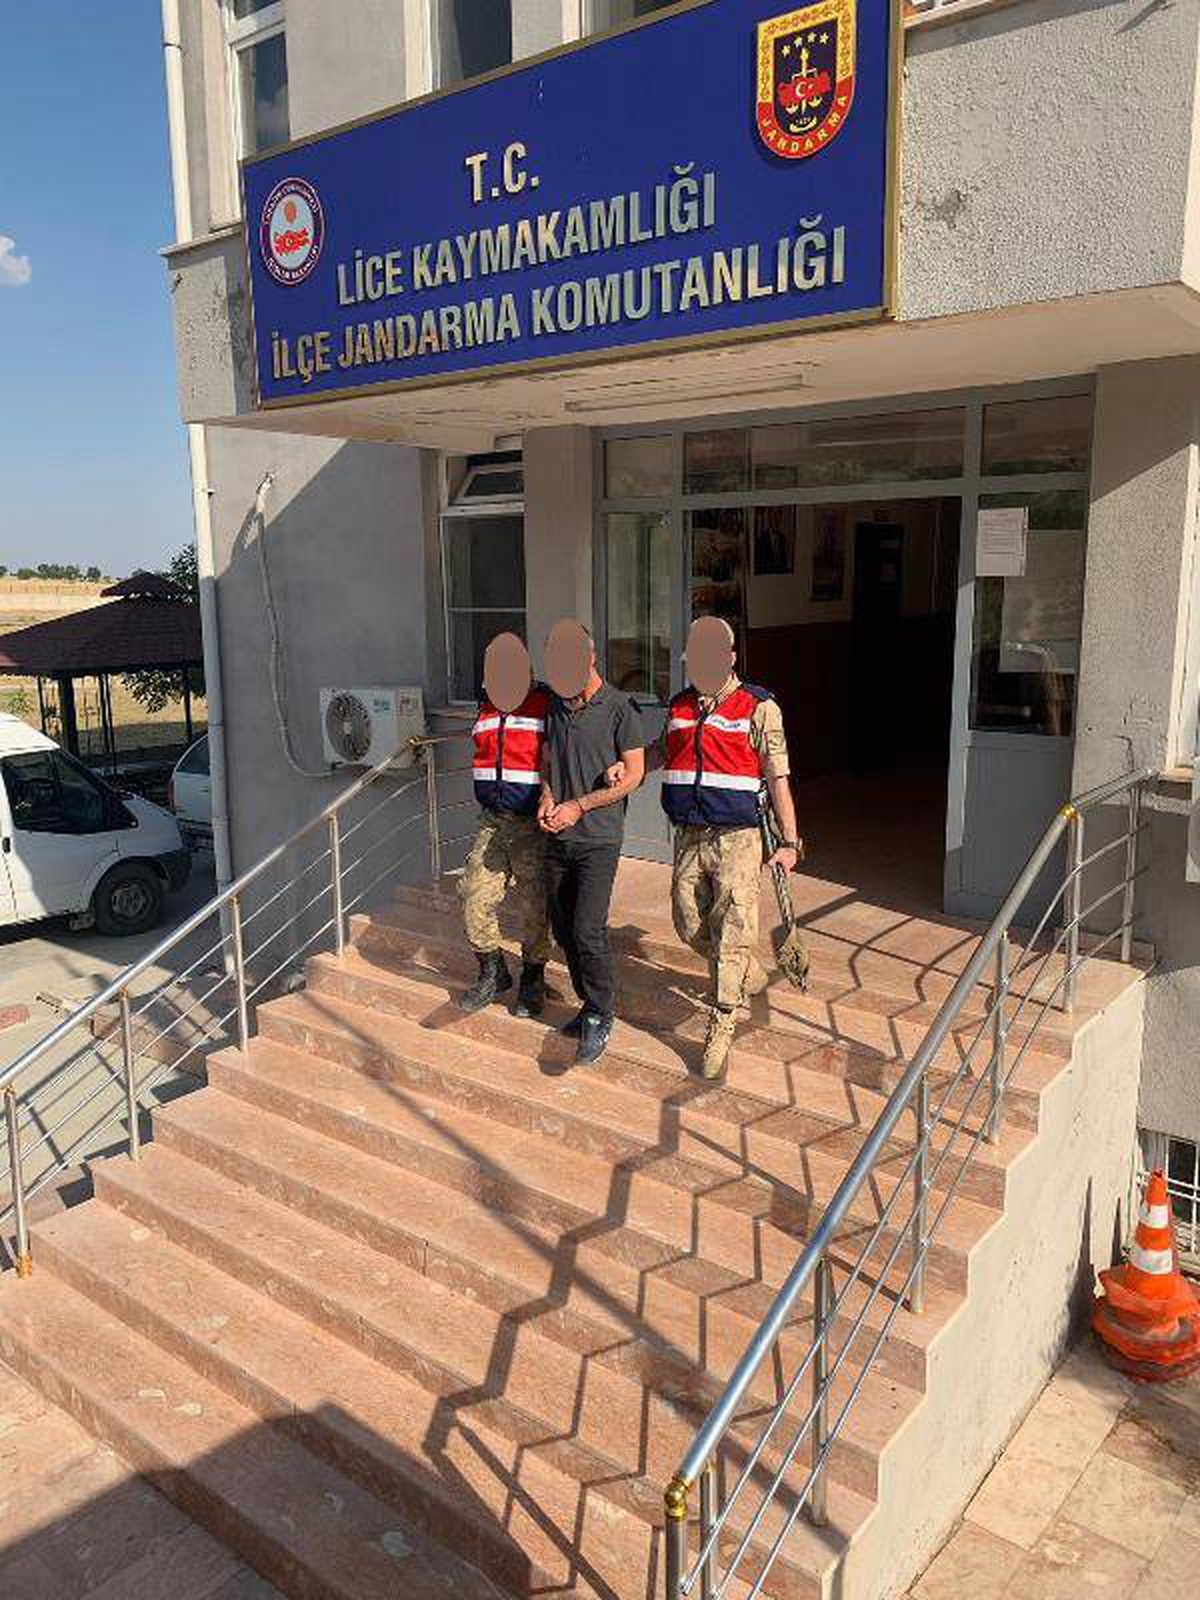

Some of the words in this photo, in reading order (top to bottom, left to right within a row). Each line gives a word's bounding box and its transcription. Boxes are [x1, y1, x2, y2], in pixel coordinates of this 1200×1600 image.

[465, 142, 539, 203] T.C.
[761, 95, 848, 151] JANDARMA
[337, 250, 403, 305] LİCE
[412, 161, 716, 290] KAYMAKAMLIĞI
[271, 331, 332, 384] İLÇE
[338, 294, 521, 368] JANDARMA
[532, 213, 846, 336] KOMUTANLIĞI
